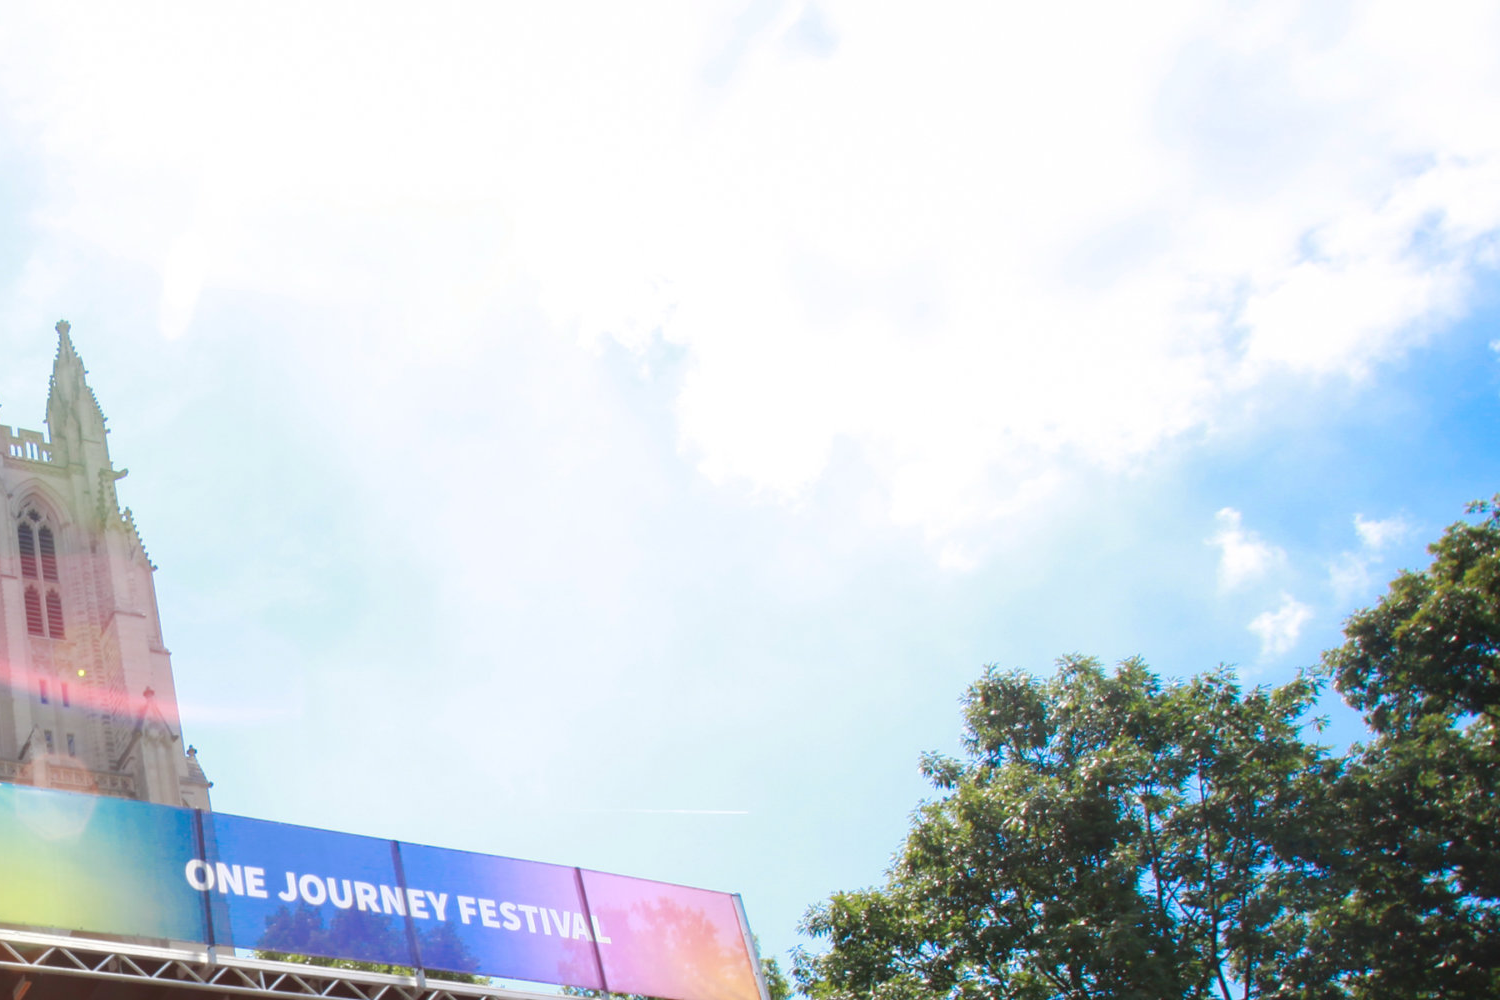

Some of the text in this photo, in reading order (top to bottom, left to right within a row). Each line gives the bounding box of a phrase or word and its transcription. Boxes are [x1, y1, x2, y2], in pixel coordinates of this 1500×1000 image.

[185, 858, 612, 945] ONE JOURNEY FESTIVAL
